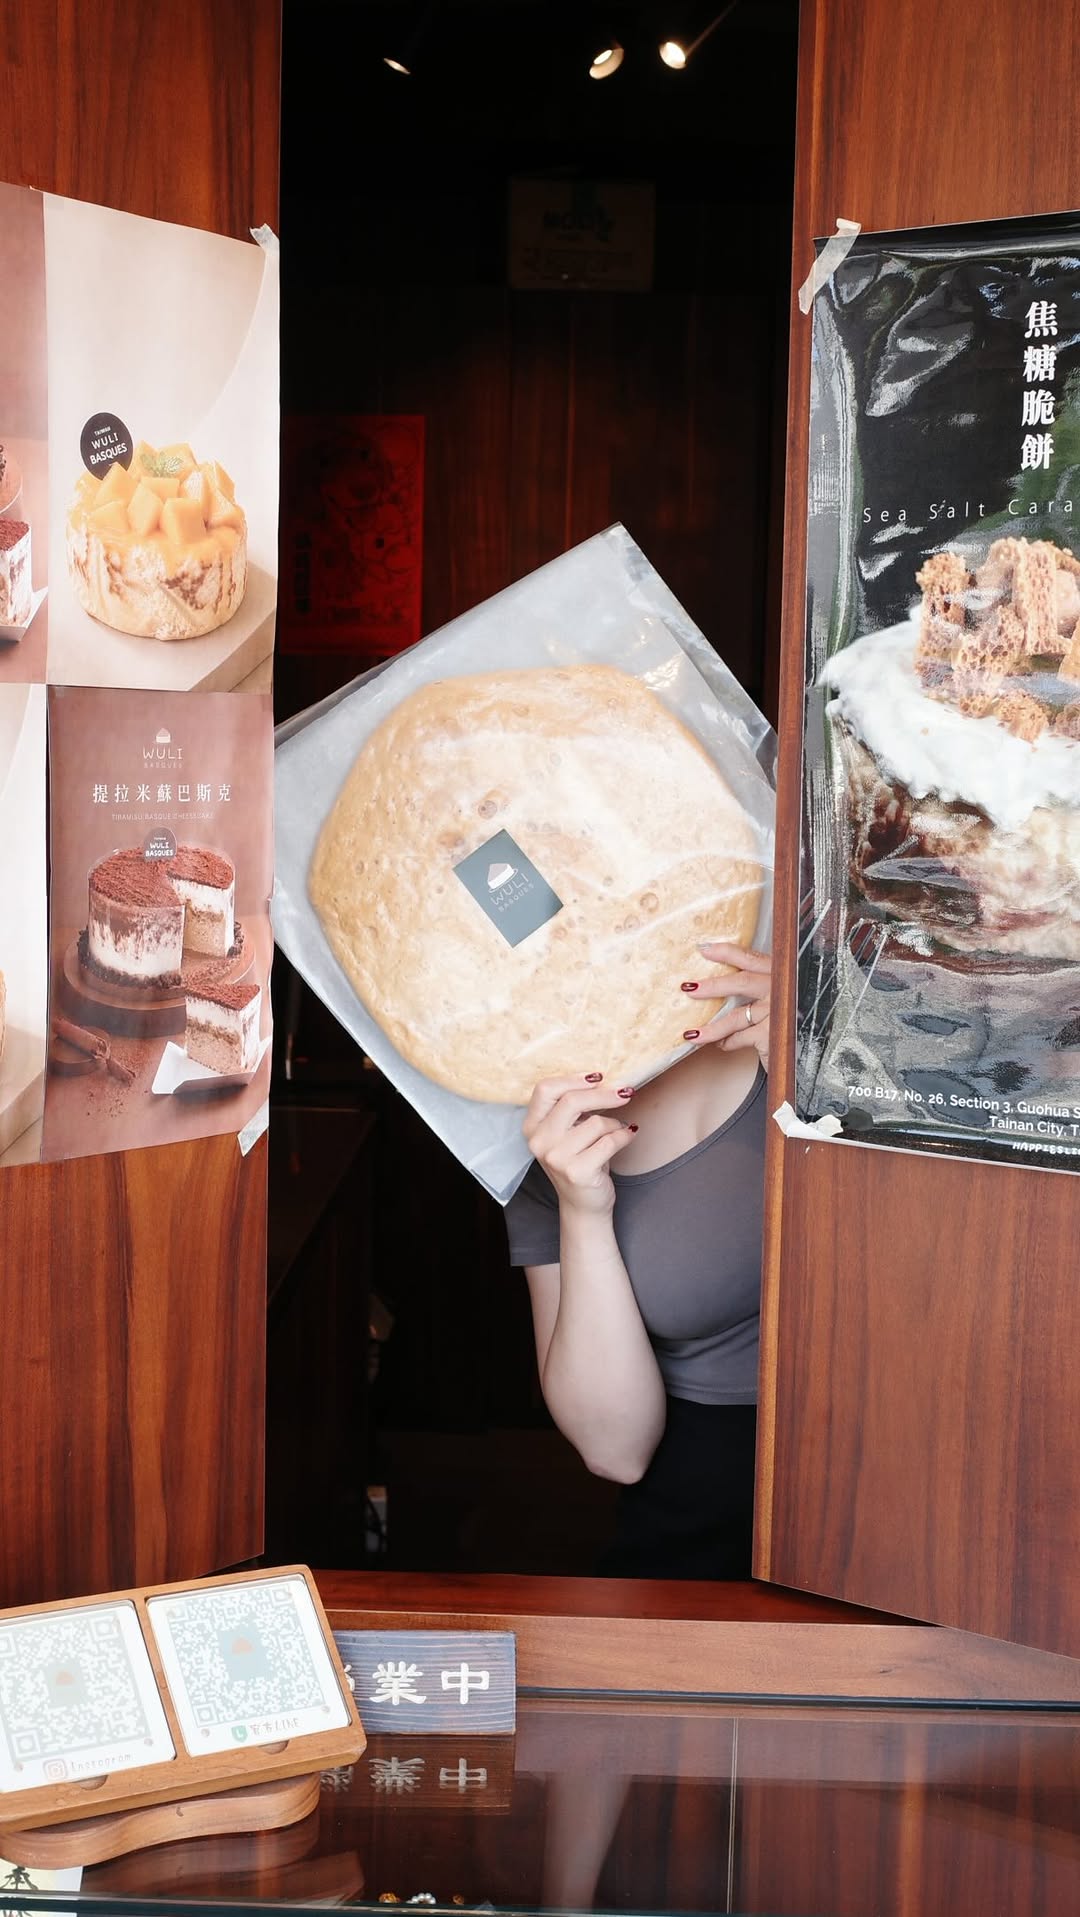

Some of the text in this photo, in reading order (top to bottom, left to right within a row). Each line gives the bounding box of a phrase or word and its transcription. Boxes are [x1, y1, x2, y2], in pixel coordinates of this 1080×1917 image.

[1021, 300, 1058, 471] 焦糖脆餅
[91, 433, 119, 449] WULI
[90, 443, 128, 464] BASQUES
[863, 498, 1073, 522] Sea Salt Cara
[143, 747, 183, 760] WULI
[93, 783, 232, 804] 提拉米蘇巴斯克
[145, 849, 174, 857] BASQUES
[491, 873, 529, 905] WULI
[848, 1085, 871, 1097] 700
[904, 1090, 925, 1103] No.
[928, 1093, 946, 1106] 26,
[950, 1094, 999, 1111] Section
[1017, 1101, 1070, 1118] Guohua
[989, 1115, 1033, 1131] Tainan
[344, 1661, 490, 1706] 業中
